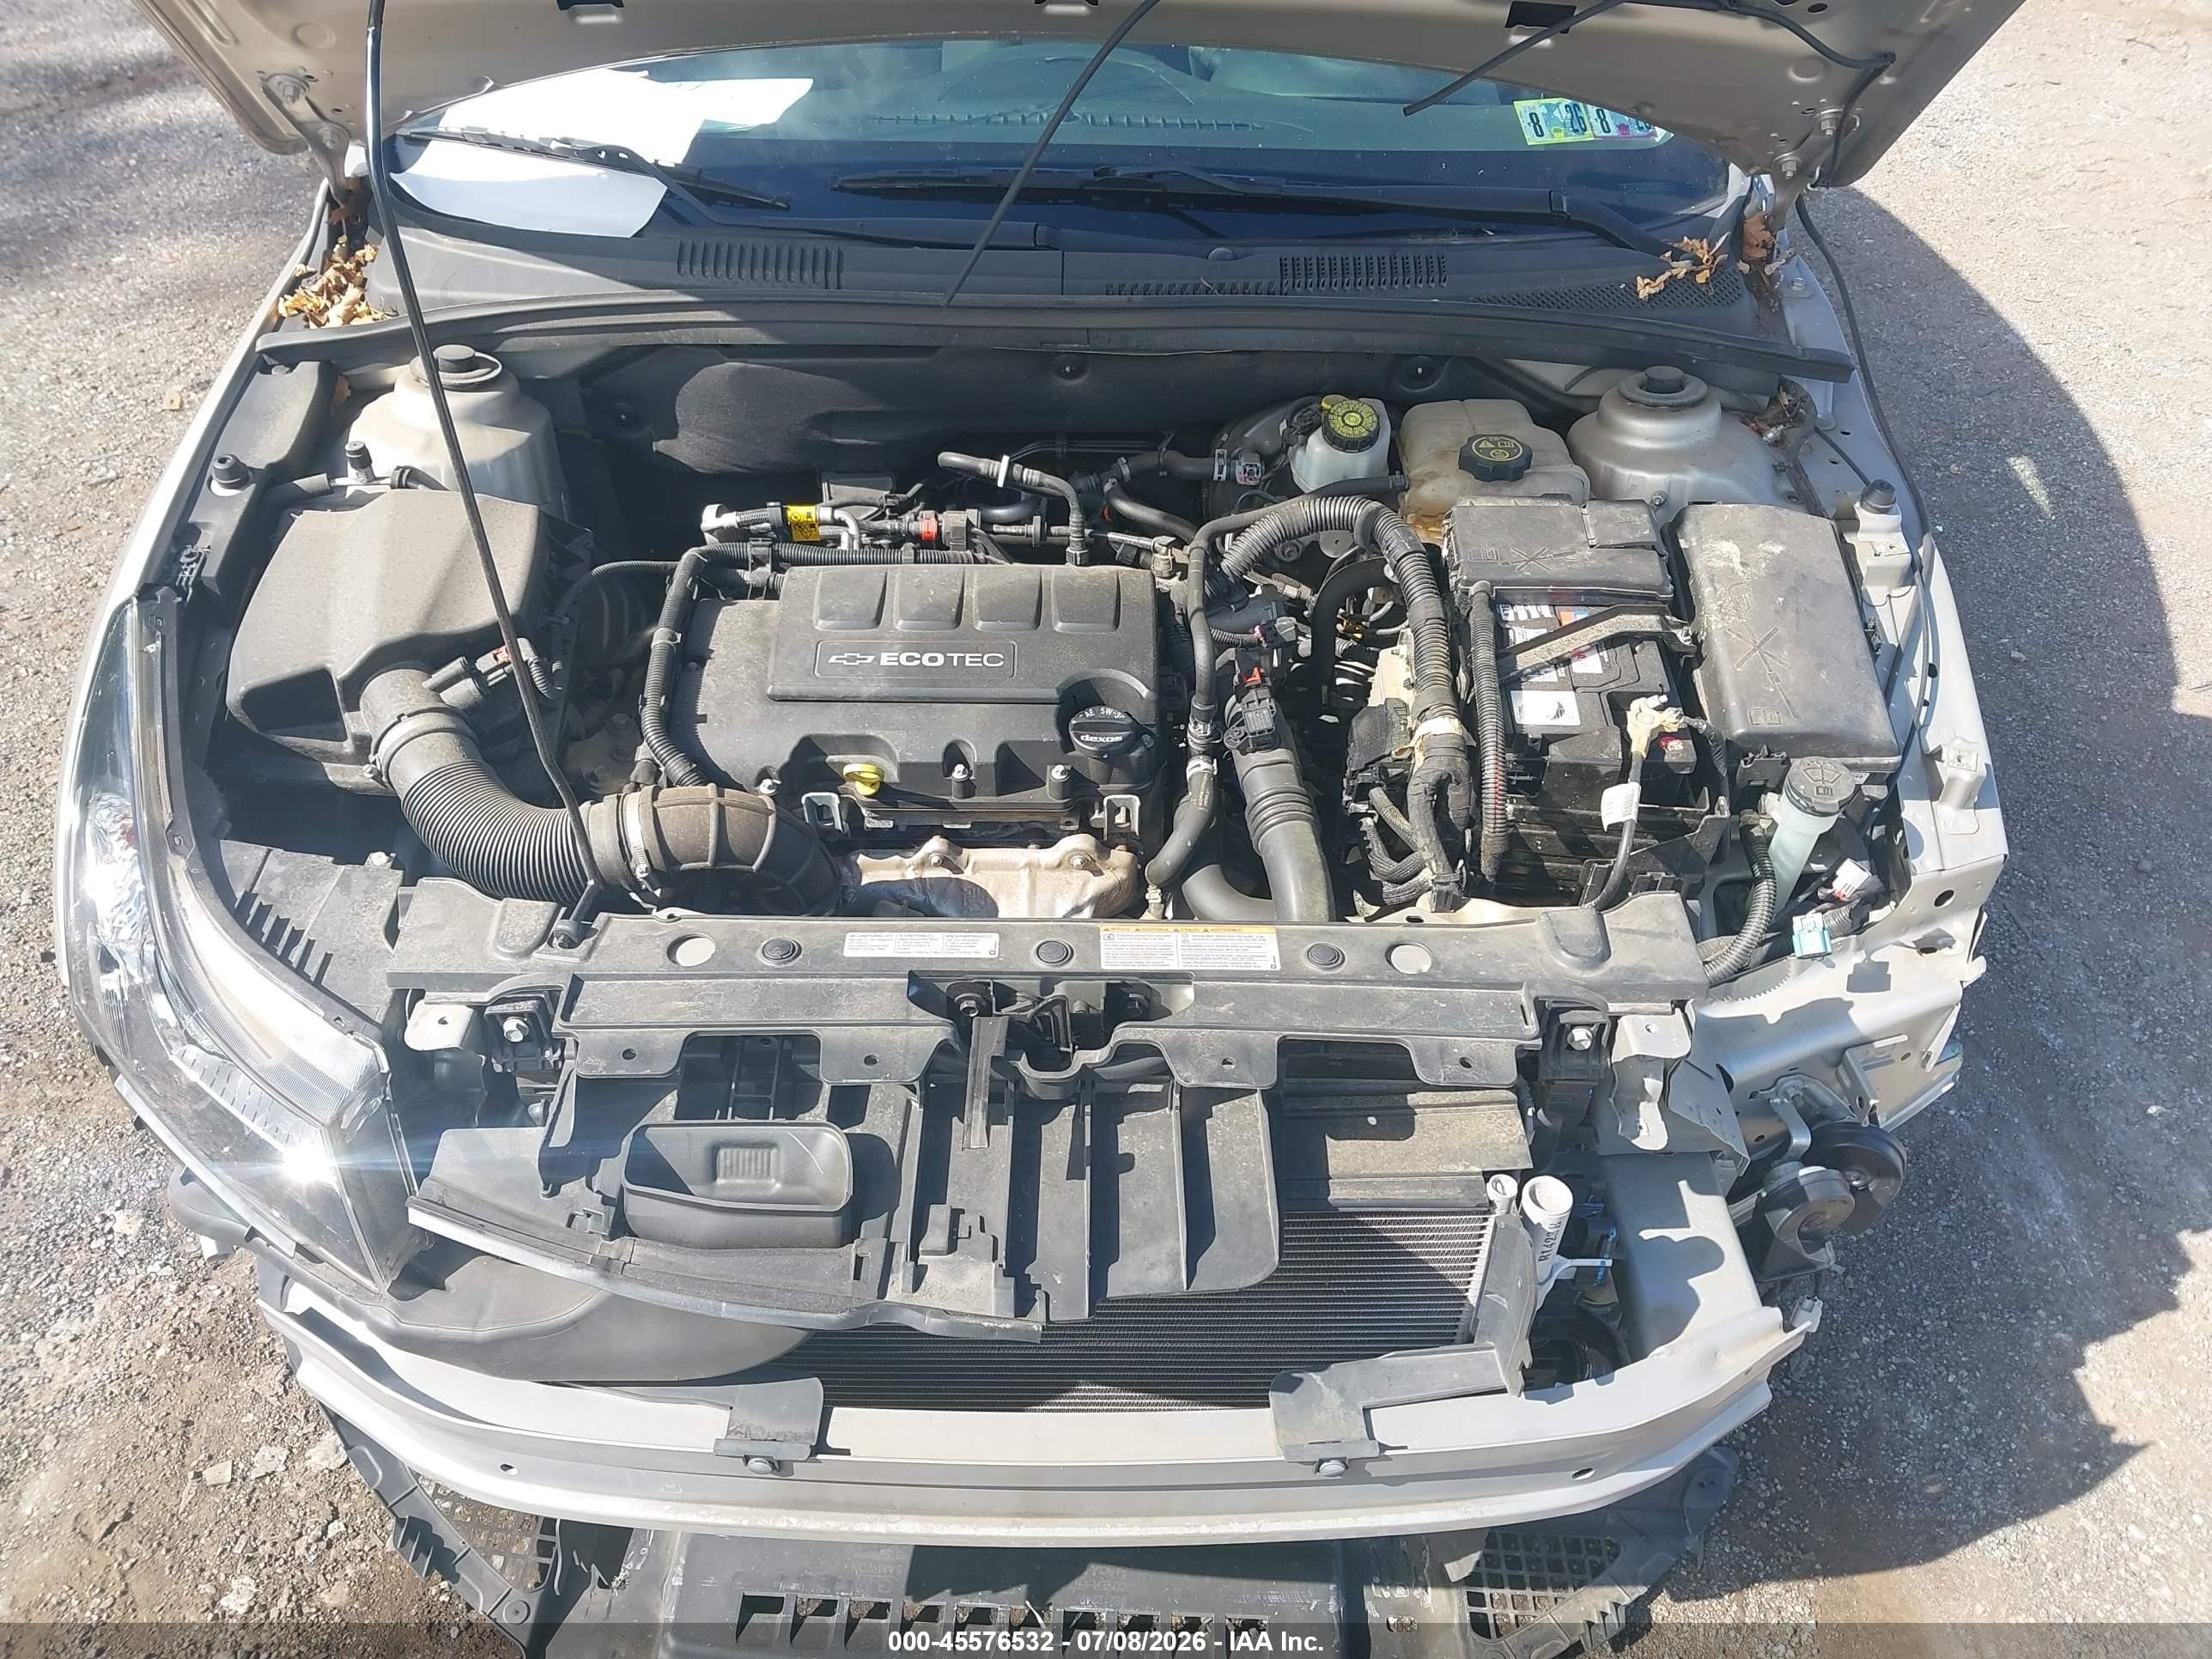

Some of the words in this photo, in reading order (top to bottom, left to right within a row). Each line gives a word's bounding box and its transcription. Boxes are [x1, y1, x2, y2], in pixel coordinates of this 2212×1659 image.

[1529, 112, 1544, 137] 8
[1565, 103, 1587, 132] 26
[1596, 109, 1611, 133] 8
[879, 652, 1005, 667] ECOTEC
[1080, 734, 1123, 743] dexos
